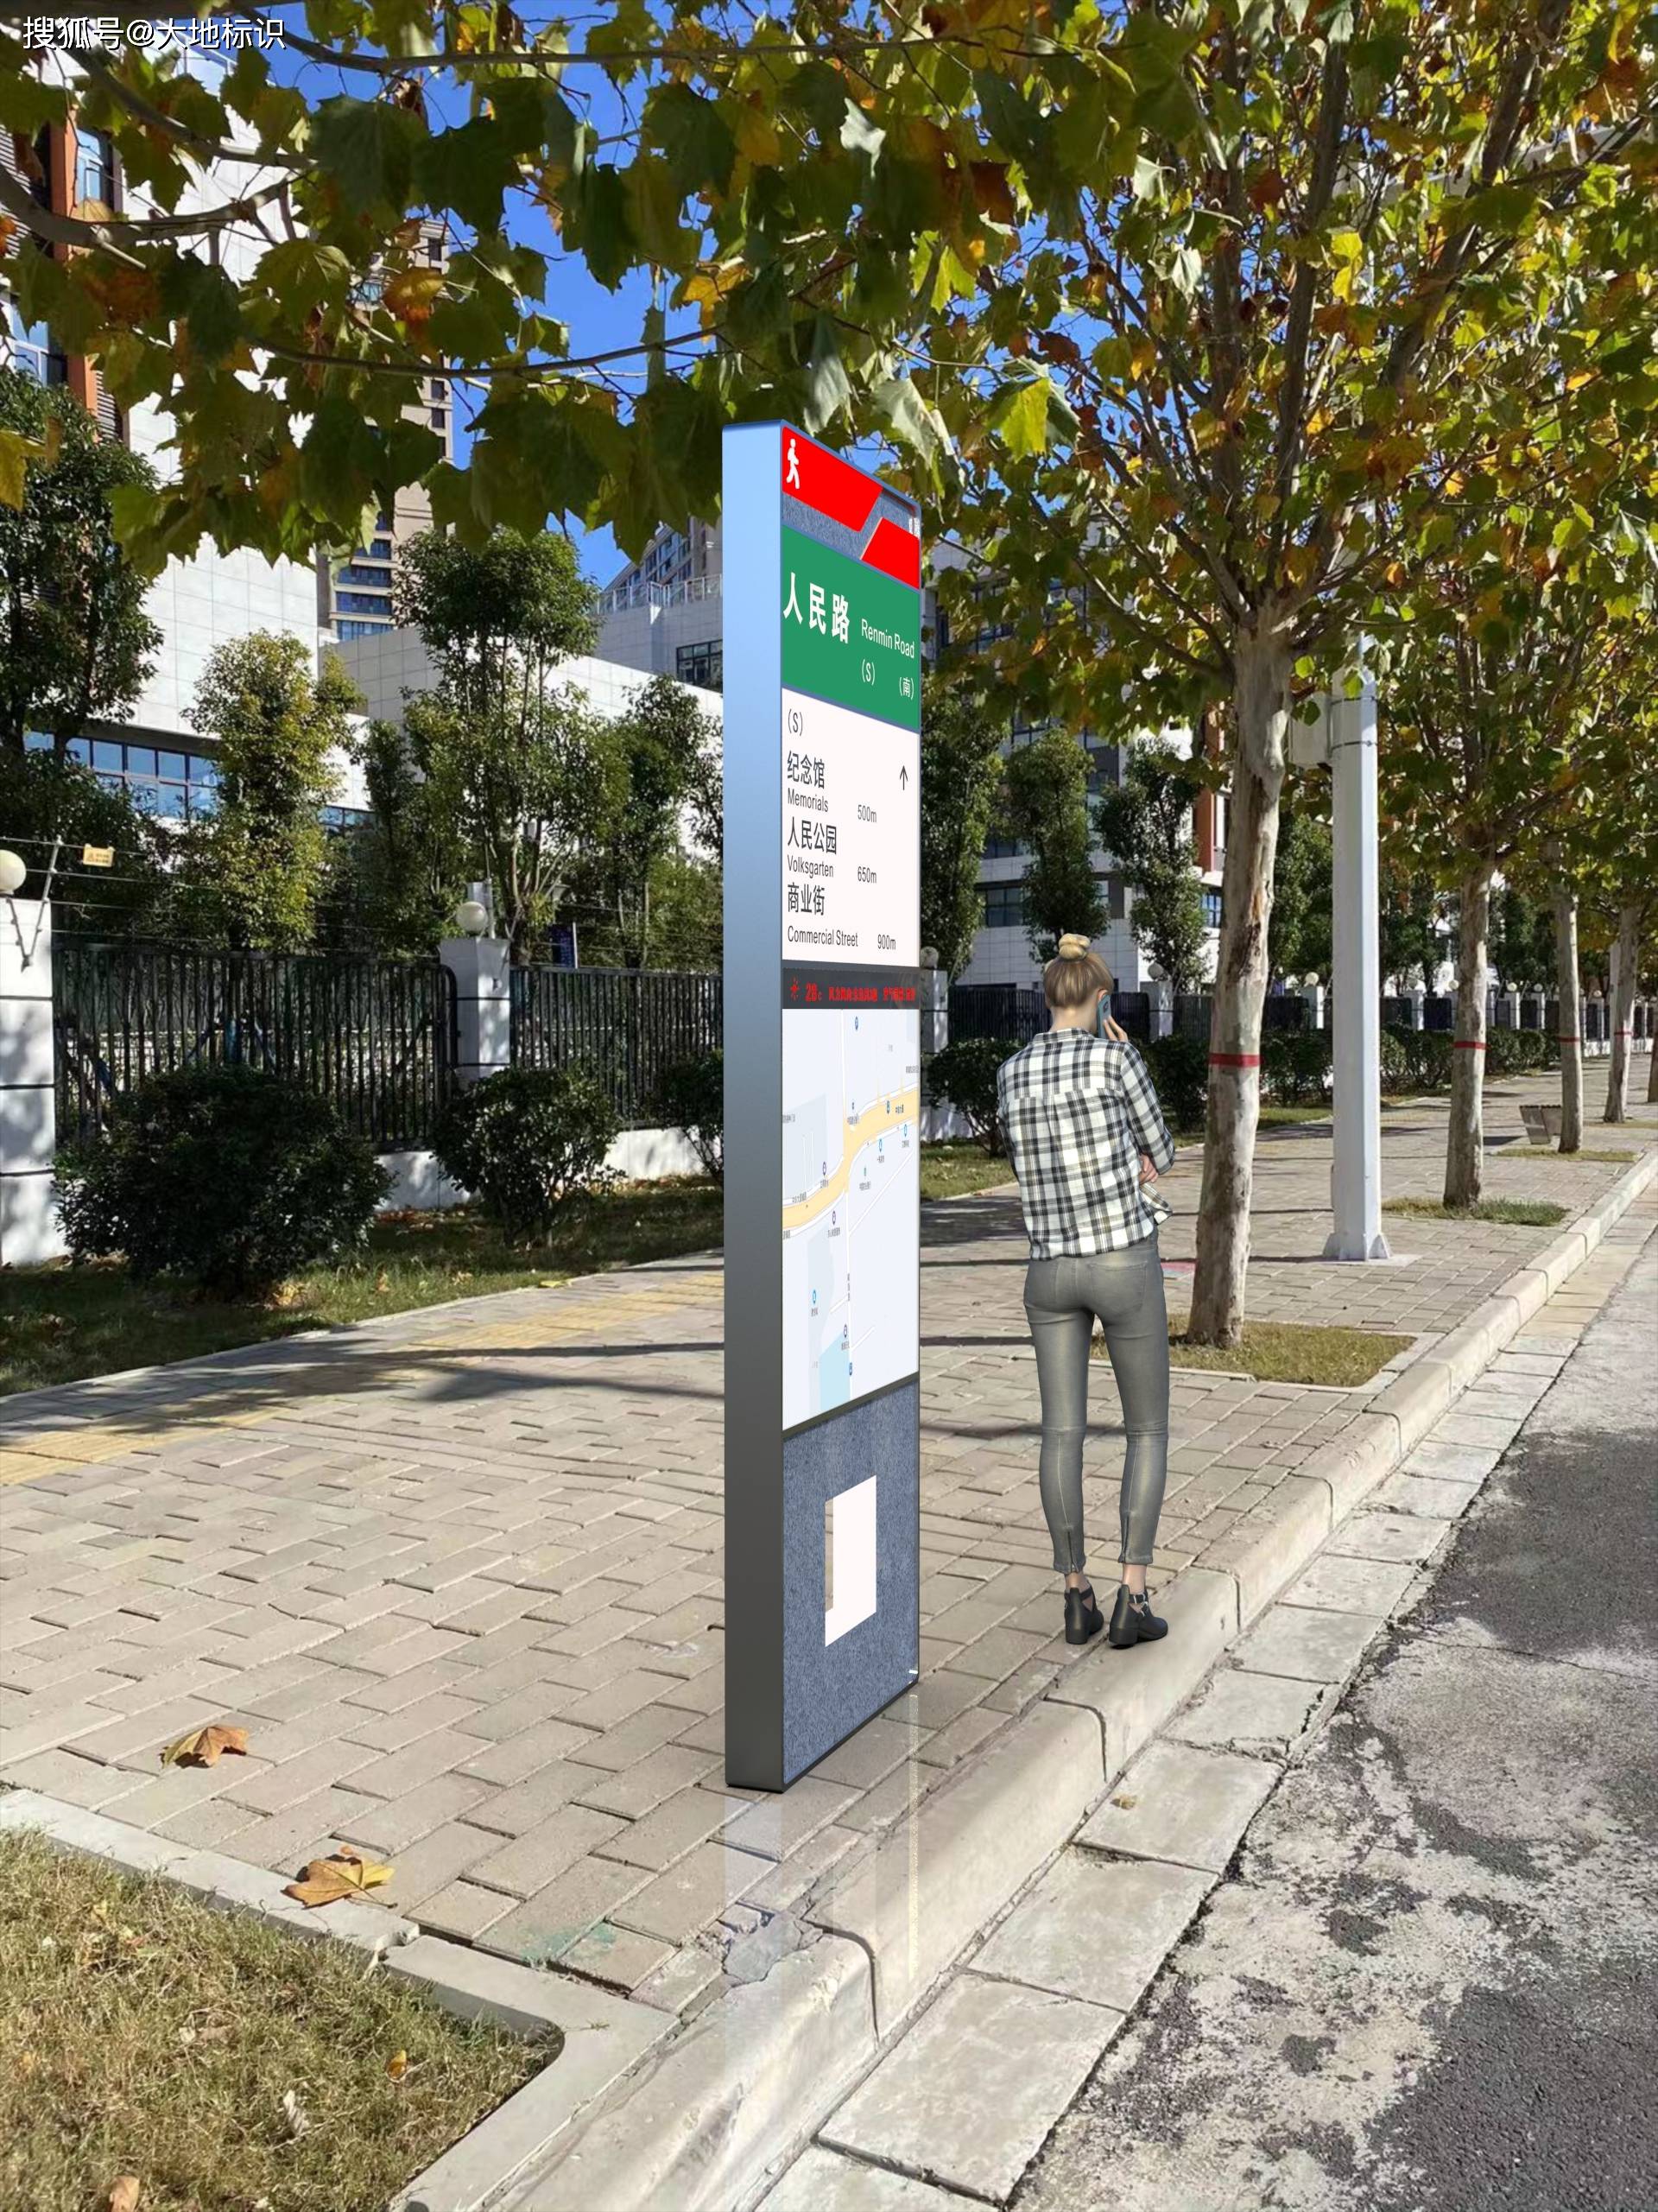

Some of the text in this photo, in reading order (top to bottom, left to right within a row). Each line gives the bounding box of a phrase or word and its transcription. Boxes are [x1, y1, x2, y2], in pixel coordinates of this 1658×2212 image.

[783, 572, 851, 644] 人民路
[861, 618, 915, 659] Renmin Road
[861, 658, 876, 686] (S)
[788, 708, 804, 737] (S)
[787, 750, 826, 789] 纪念馆
[787, 787, 877, 823] Memorials 500m
[787, 816, 838, 855] 人民公园
[787, 854, 877, 884] Volksgarten 650m
[787, 882, 826, 916] 商业街
[787, 925, 896, 951] Commercial Street 900m
